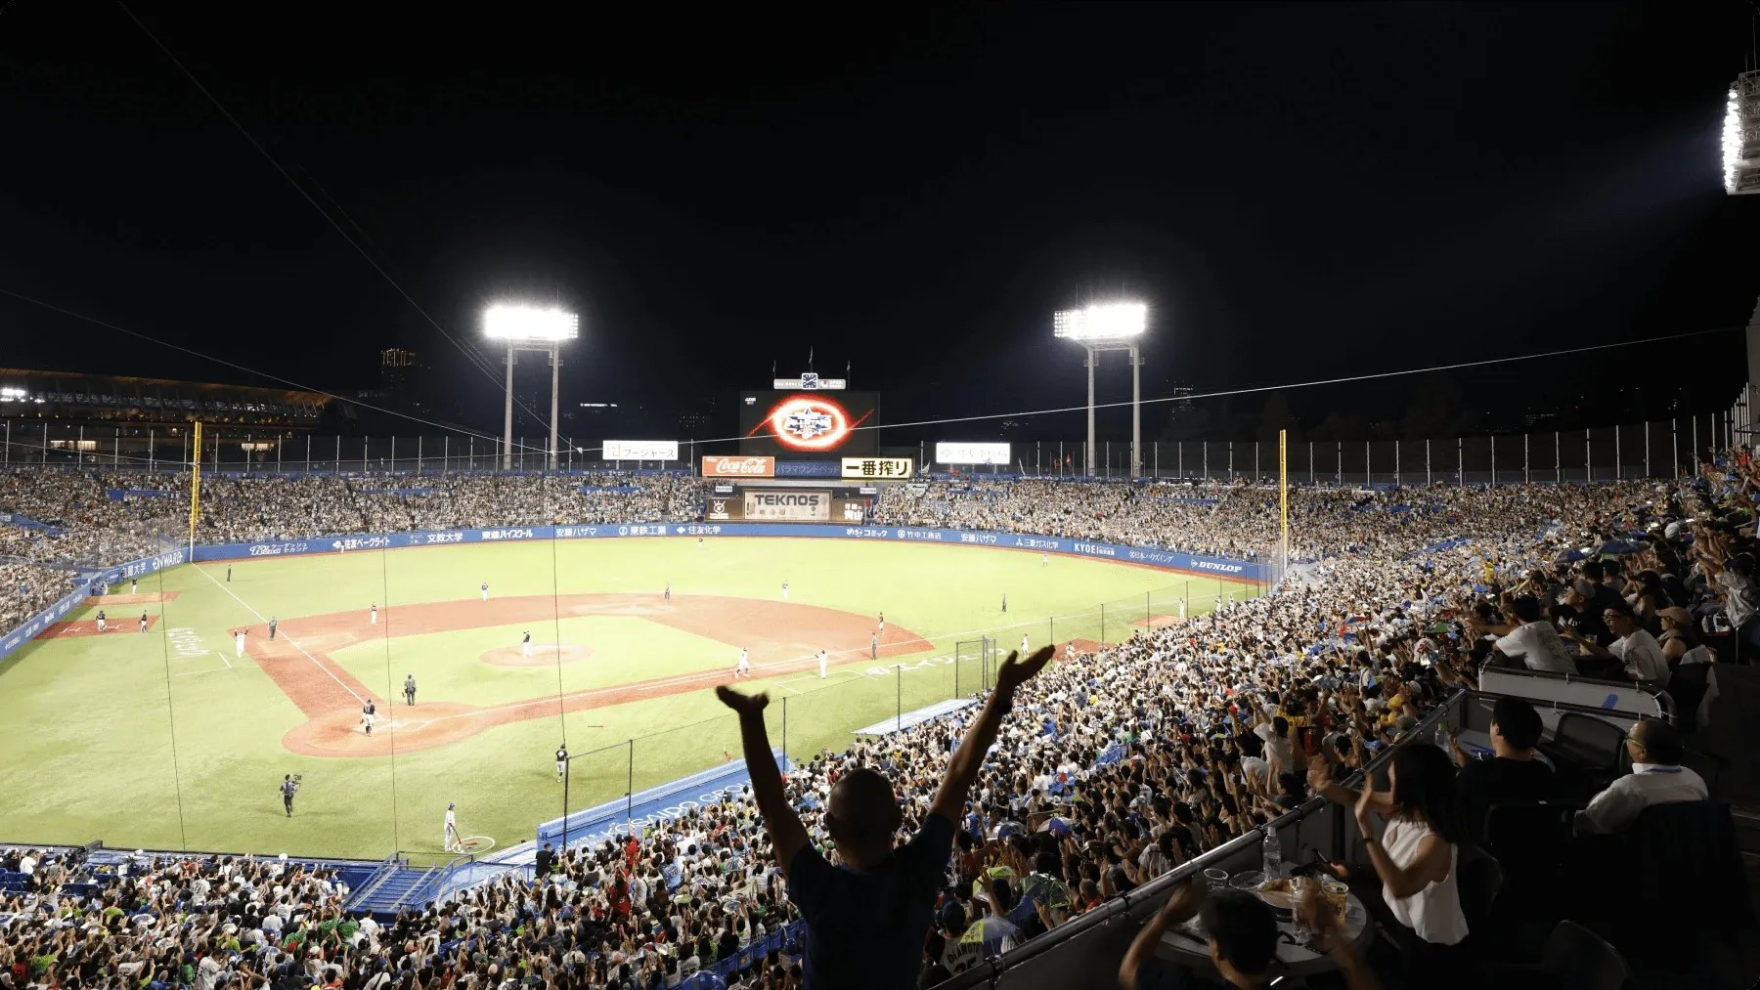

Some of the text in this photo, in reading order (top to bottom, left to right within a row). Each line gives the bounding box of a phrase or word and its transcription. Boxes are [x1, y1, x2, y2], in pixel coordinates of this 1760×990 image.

[623, 448, 675, 458] フージャース
[716, 457, 767, 475] Coca-Cola
[776, 464, 841, 476] パラマウントベッド
[846, 460, 908, 476] 一番搾り
[754, 494, 819, 507] TEKNOS
[482, 528, 533, 540] 東進ハイスクール
[556, 527, 597, 537] 安藤ハザマ
[630, 526, 666, 535] 東鉄工業
[688, 526, 721, 535] 住友化学
[907, 531, 942, 540] 竹中工務店
[427, 532, 463, 544] 文教大学
[1198, 560, 1243, 573] DUNLOP
